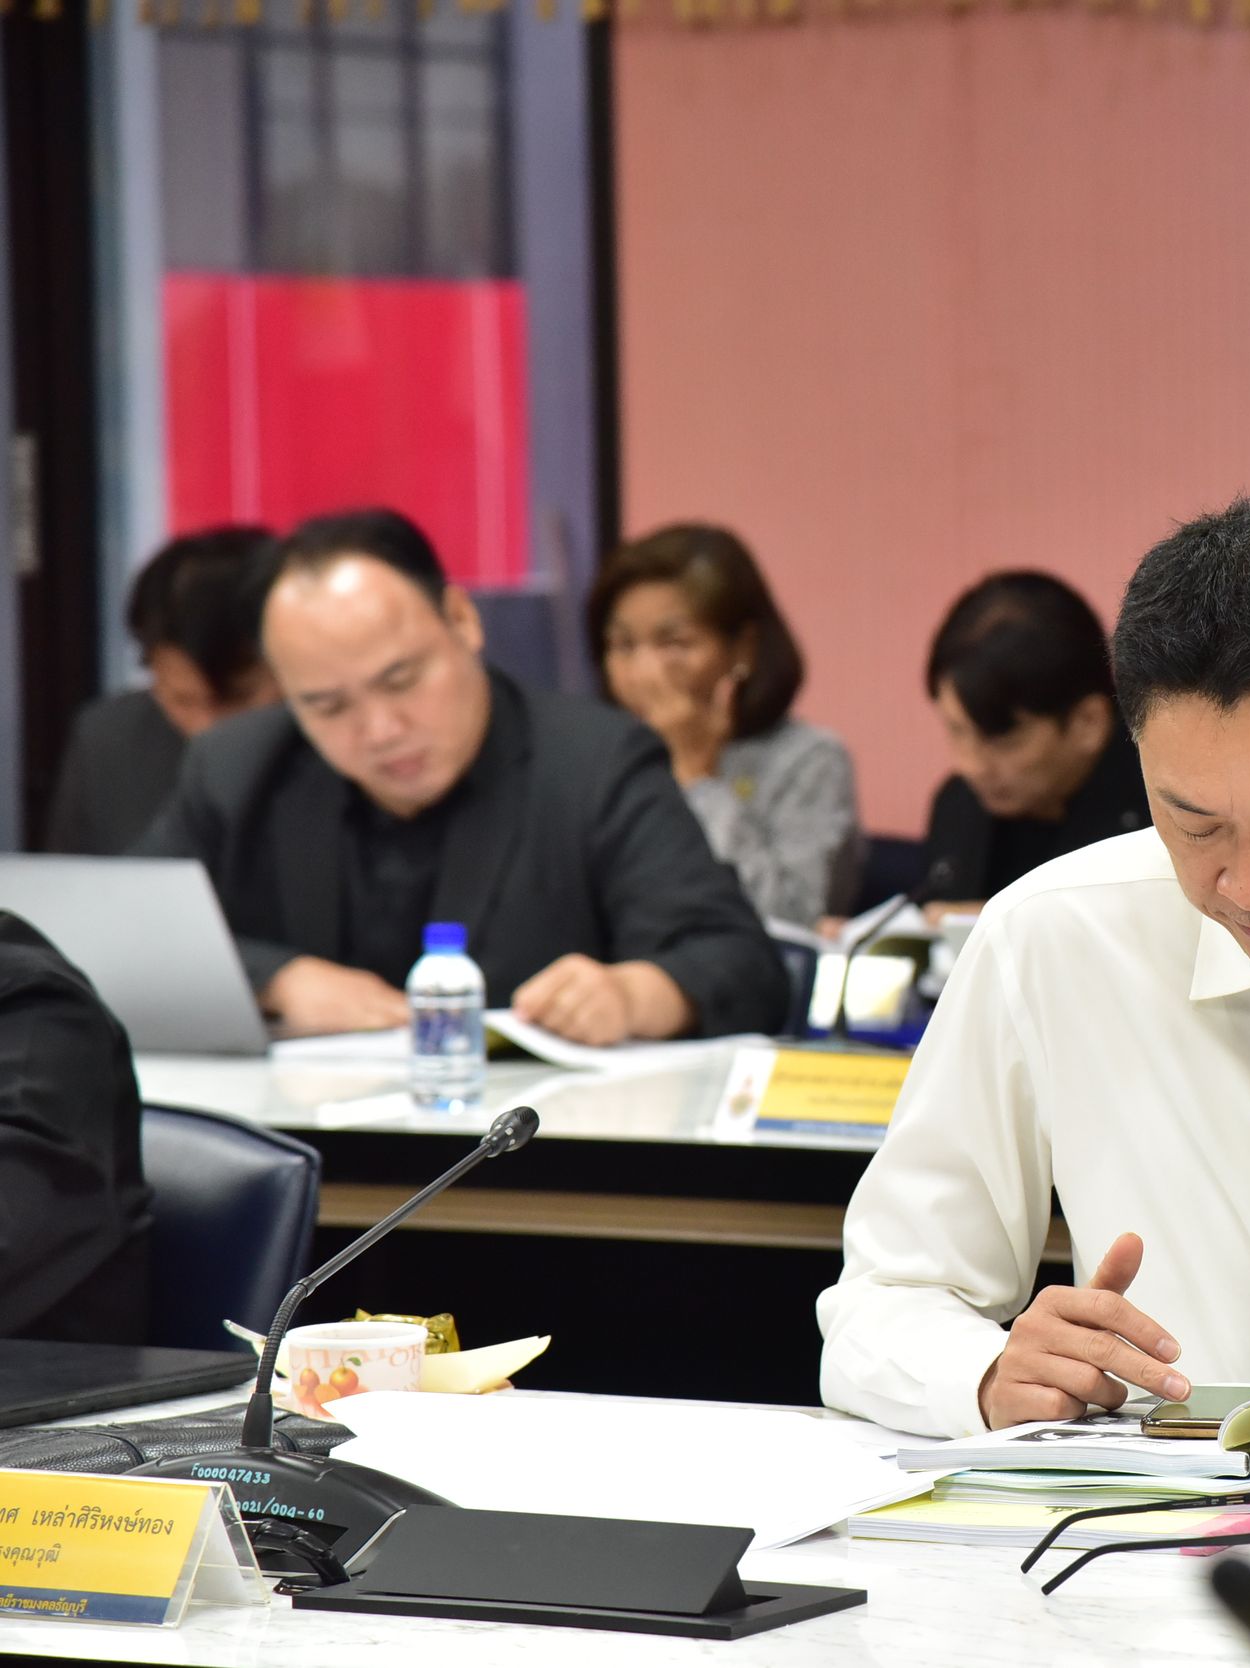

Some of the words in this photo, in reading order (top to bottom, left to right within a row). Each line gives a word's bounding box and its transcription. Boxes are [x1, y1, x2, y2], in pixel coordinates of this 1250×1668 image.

[31, 1504, 175, 1536] เหล่าศิริหงษ์ทอง
